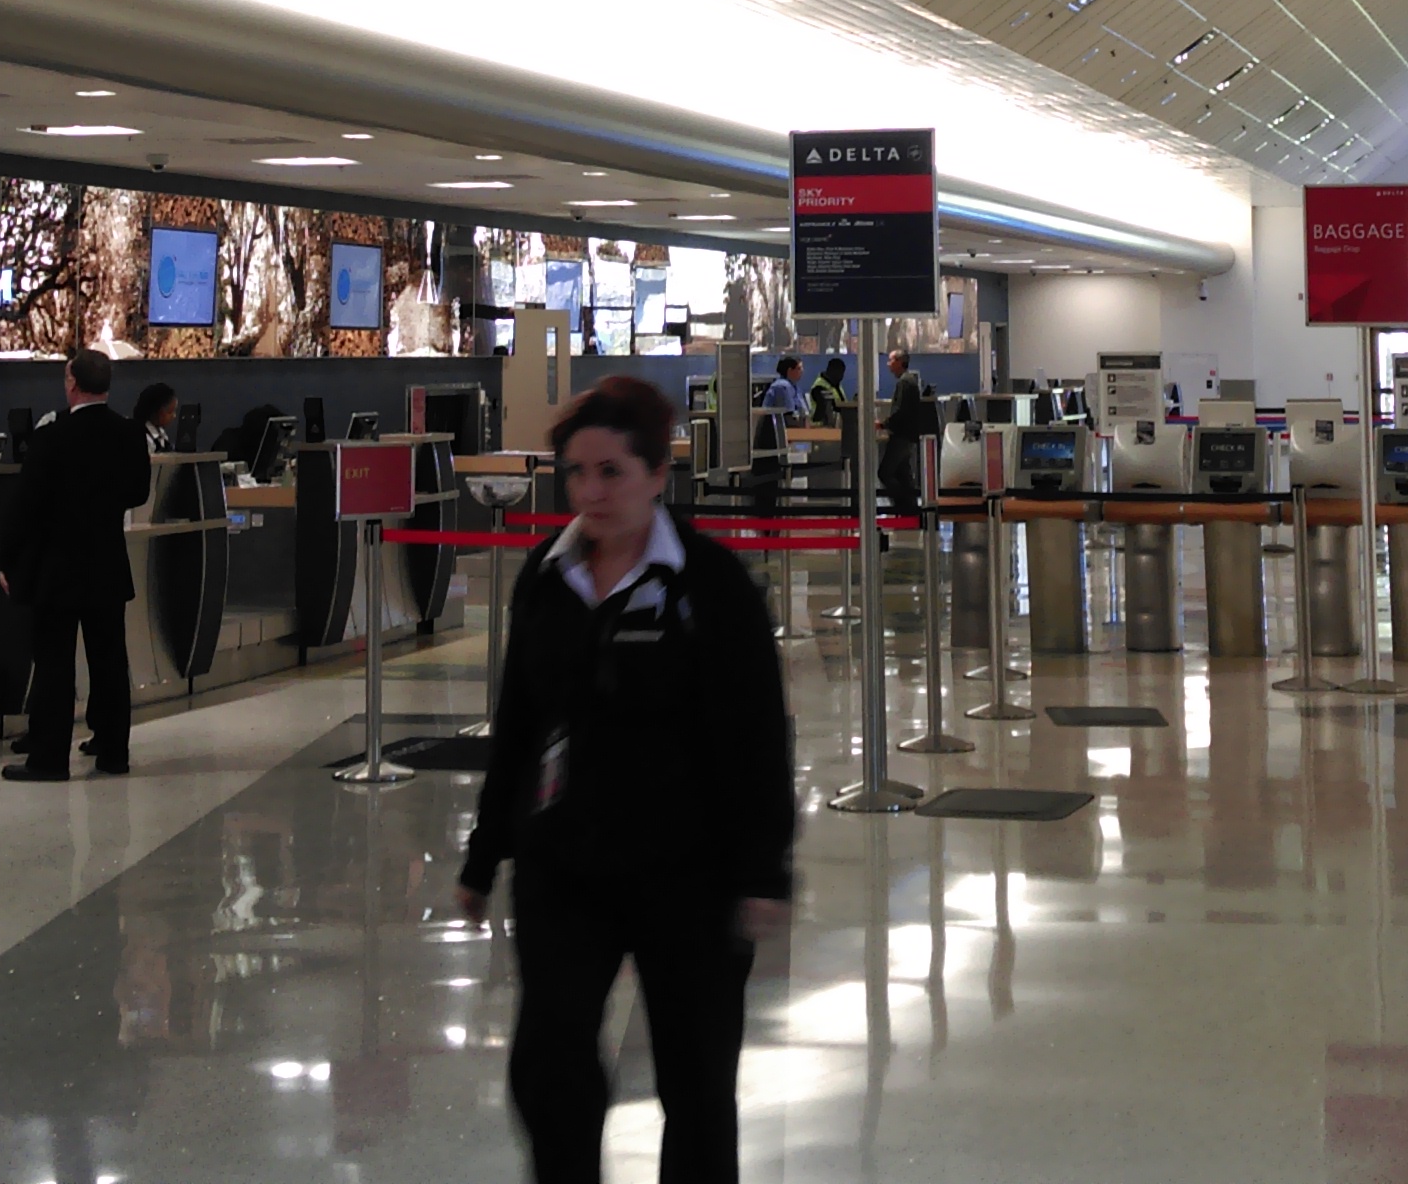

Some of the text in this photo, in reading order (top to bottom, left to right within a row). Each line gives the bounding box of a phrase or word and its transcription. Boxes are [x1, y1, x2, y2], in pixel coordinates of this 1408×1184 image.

[829, 146, 900, 162] DELTA
[798, 188, 823, 197] SKY
[798, 197, 855, 207] PRIORITY
[1313, 223, 1405, 240] BAGGAGE
[344, 467, 370, 480] EXIT
